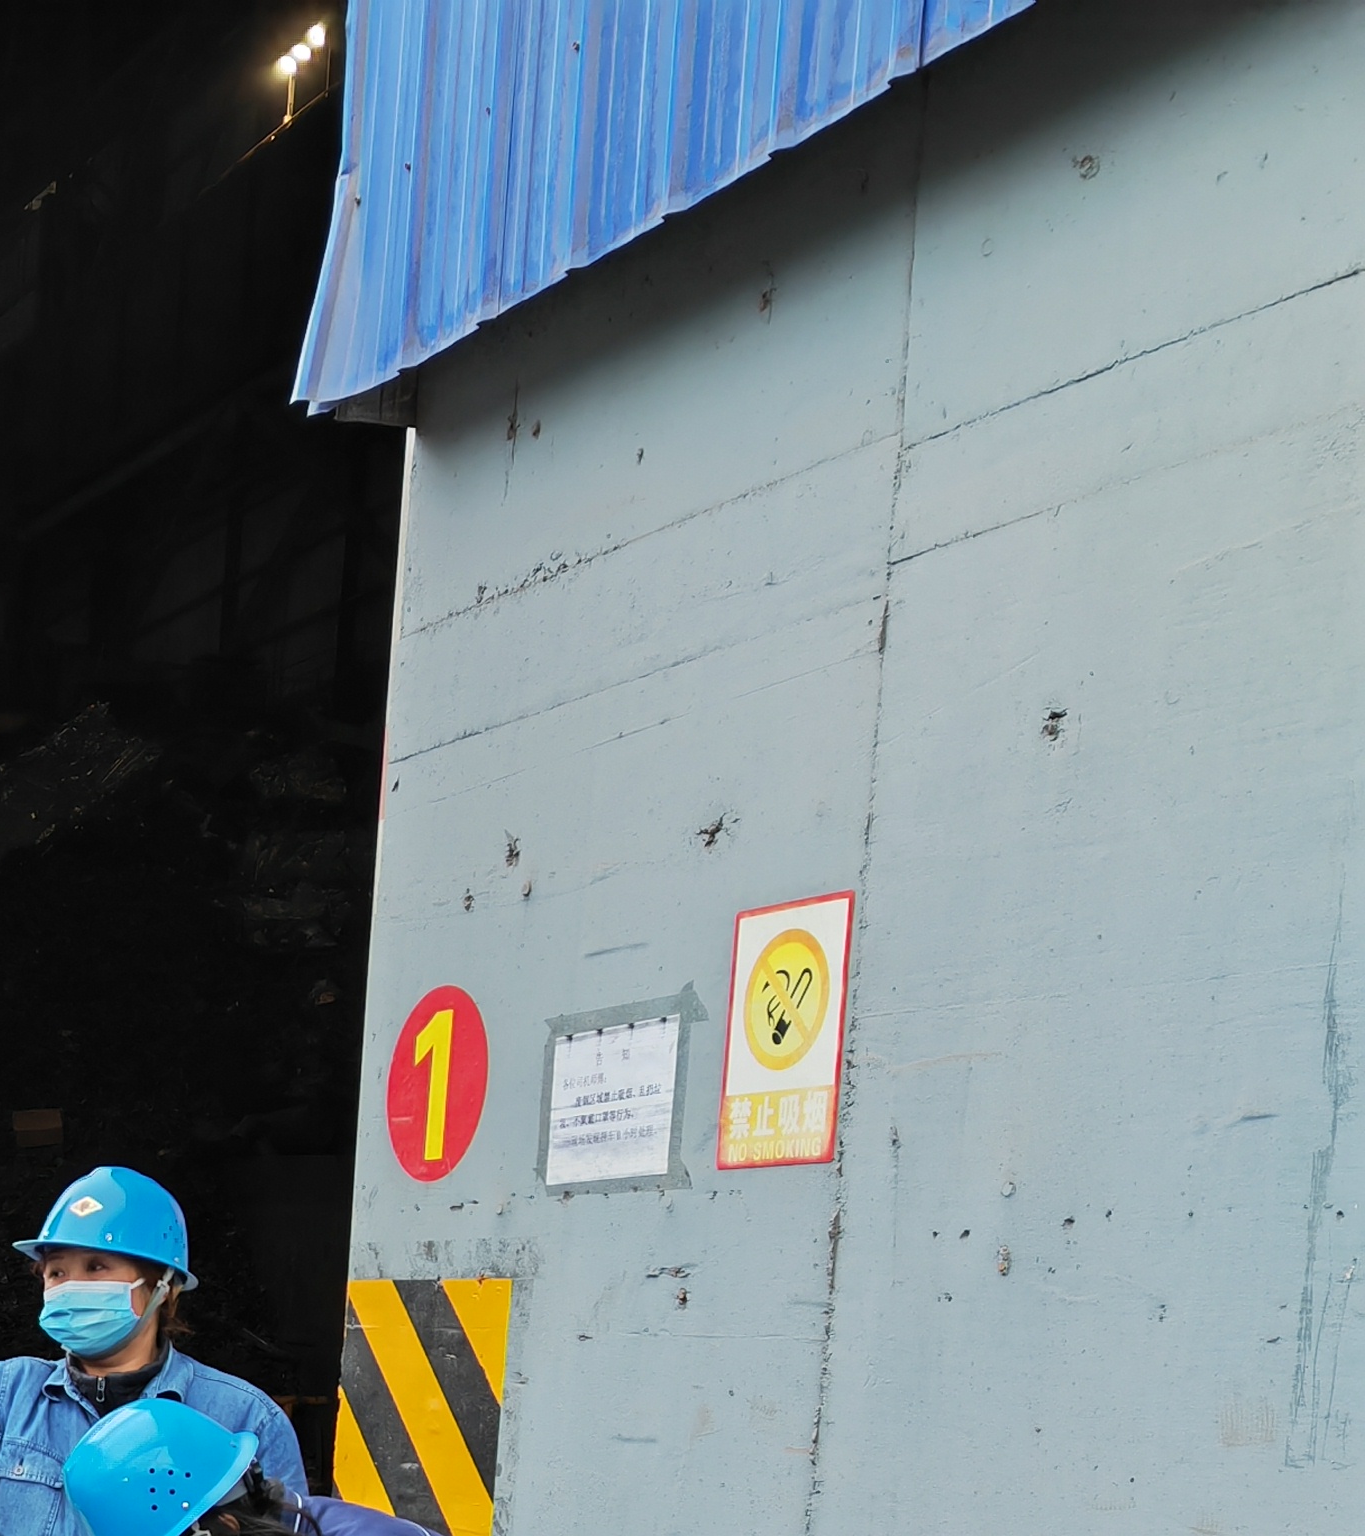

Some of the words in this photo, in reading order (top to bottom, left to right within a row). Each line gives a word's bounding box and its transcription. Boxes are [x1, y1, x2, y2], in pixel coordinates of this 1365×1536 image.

[414, 1008, 454, 1162] 1
[729, 1090, 829, 1140] 禁止吸烟
[728, 1143, 747, 1163] NO
[753, 1136, 822, 1160] SMOKING
